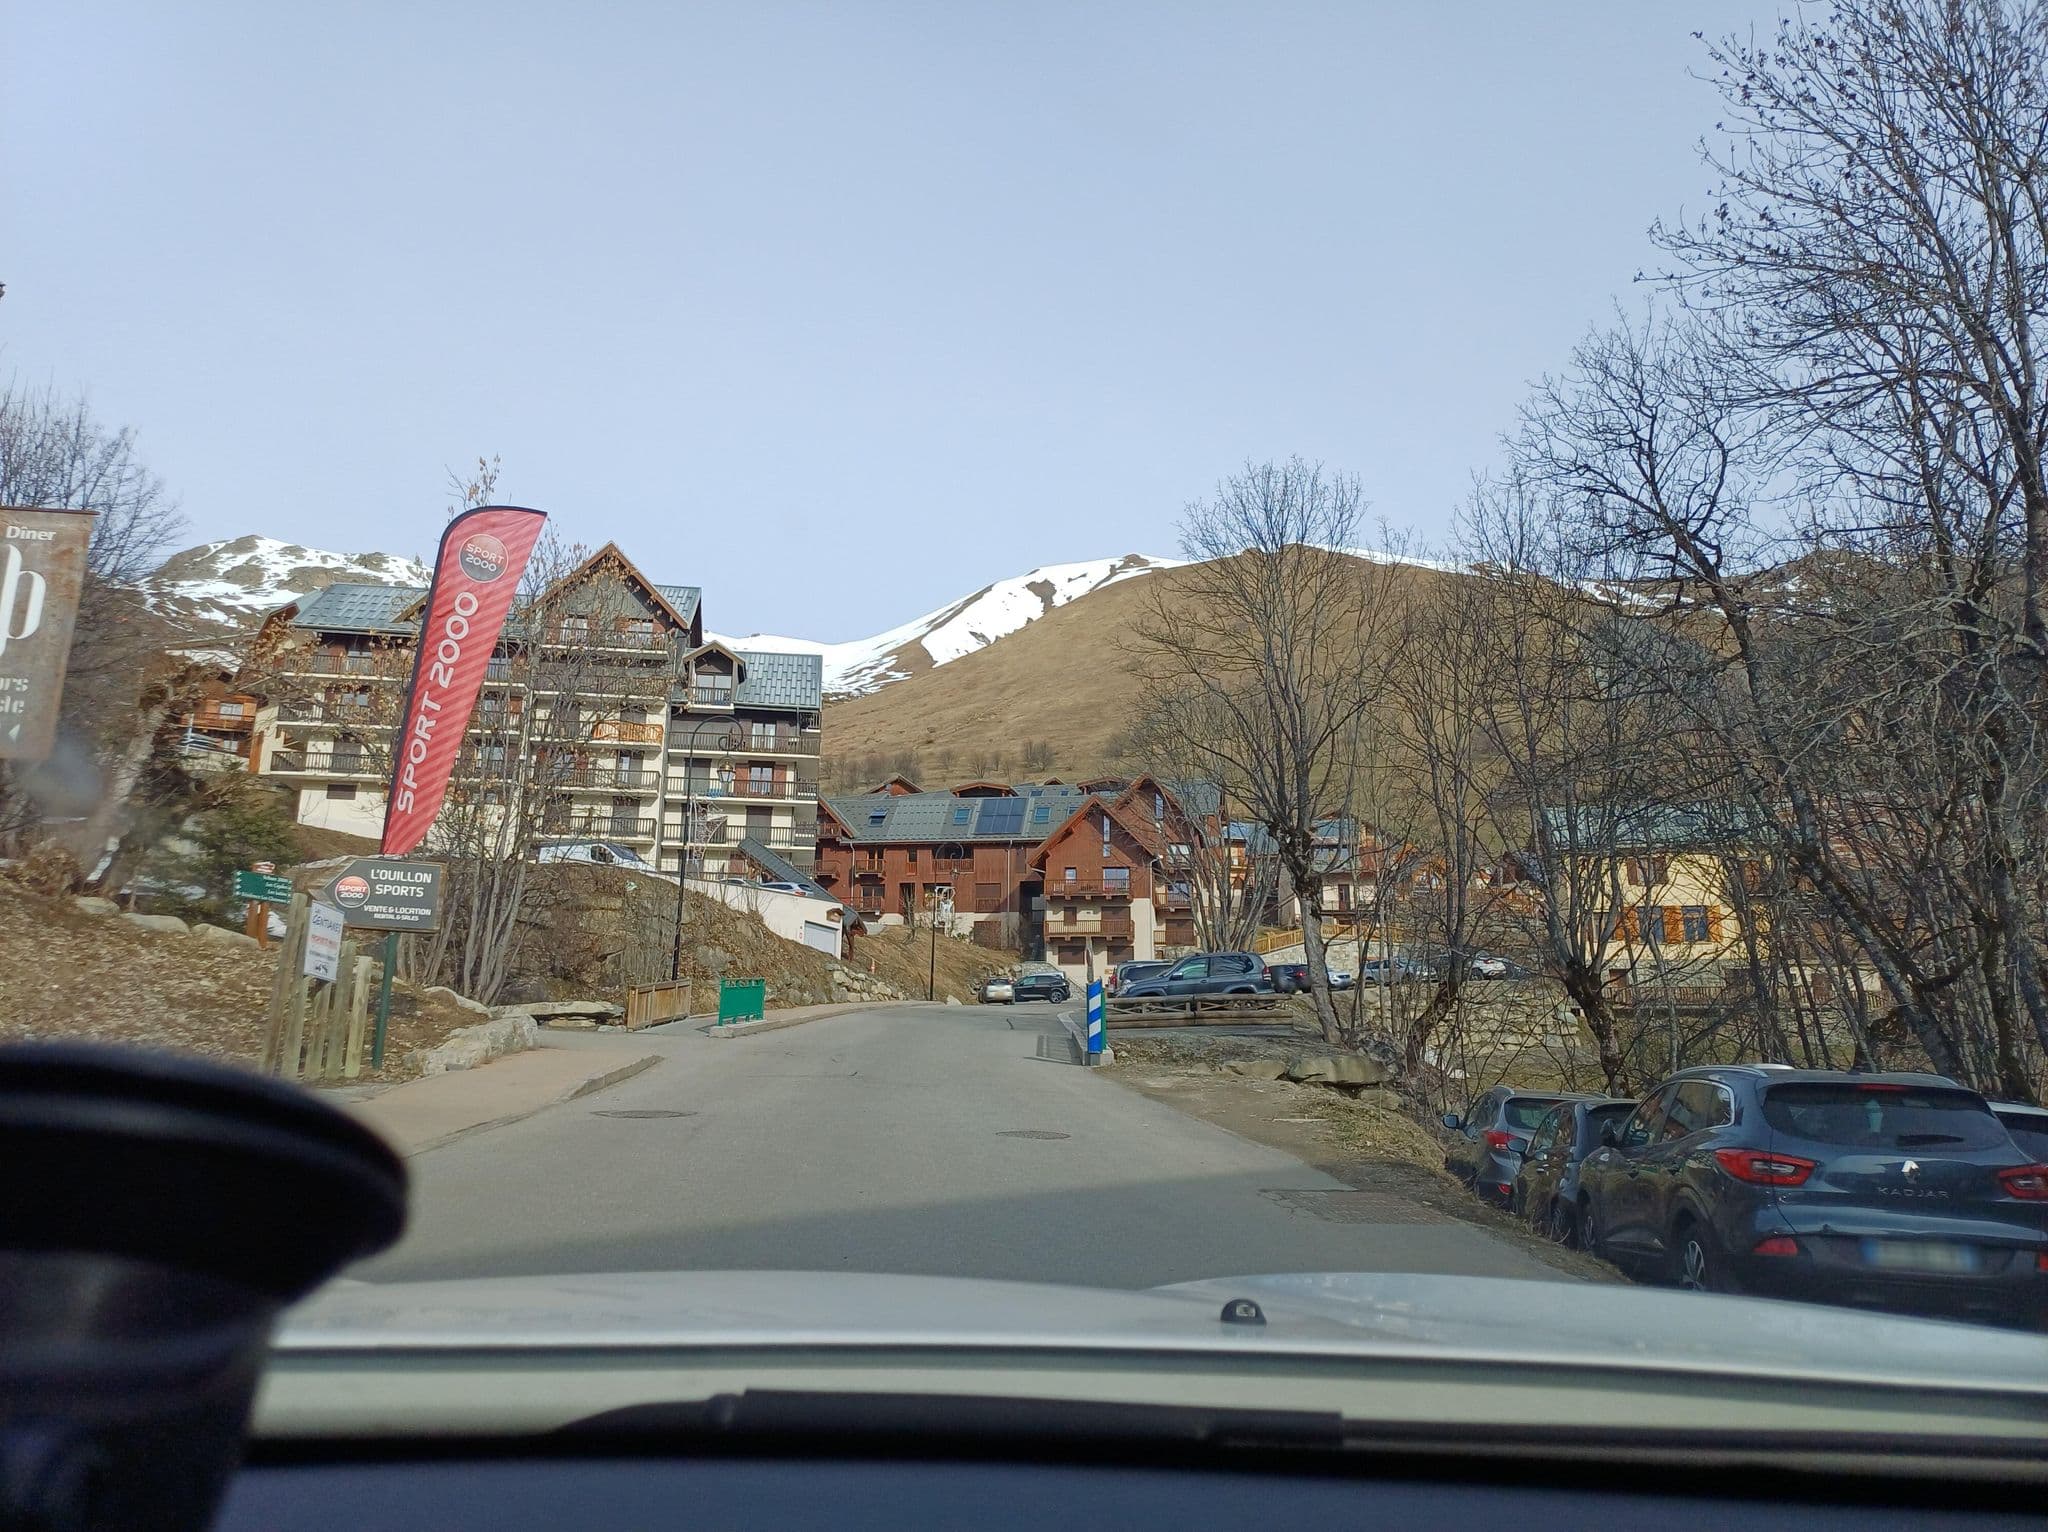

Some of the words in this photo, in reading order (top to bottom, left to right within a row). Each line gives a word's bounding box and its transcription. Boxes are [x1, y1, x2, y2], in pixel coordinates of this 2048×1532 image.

[6, 525, 57, 541] Dîner
[466, 543, 504, 564] SPORT
[465, 553, 497, 572] 2000
[397, 691, 442, 814] SPORT
[429, 591, 479, 689] 2000
[370, 868, 432, 884] L'OUILLON
[338, 885, 367, 893] SPORT
[340, 891, 364, 899] 2000
[375, 883, 424, 898] SPORTS
[363, 904, 388, 913] VENTE
[395, 907, 432, 916] LOCATION
[1878, 1186, 1951, 1199] KADJAR
